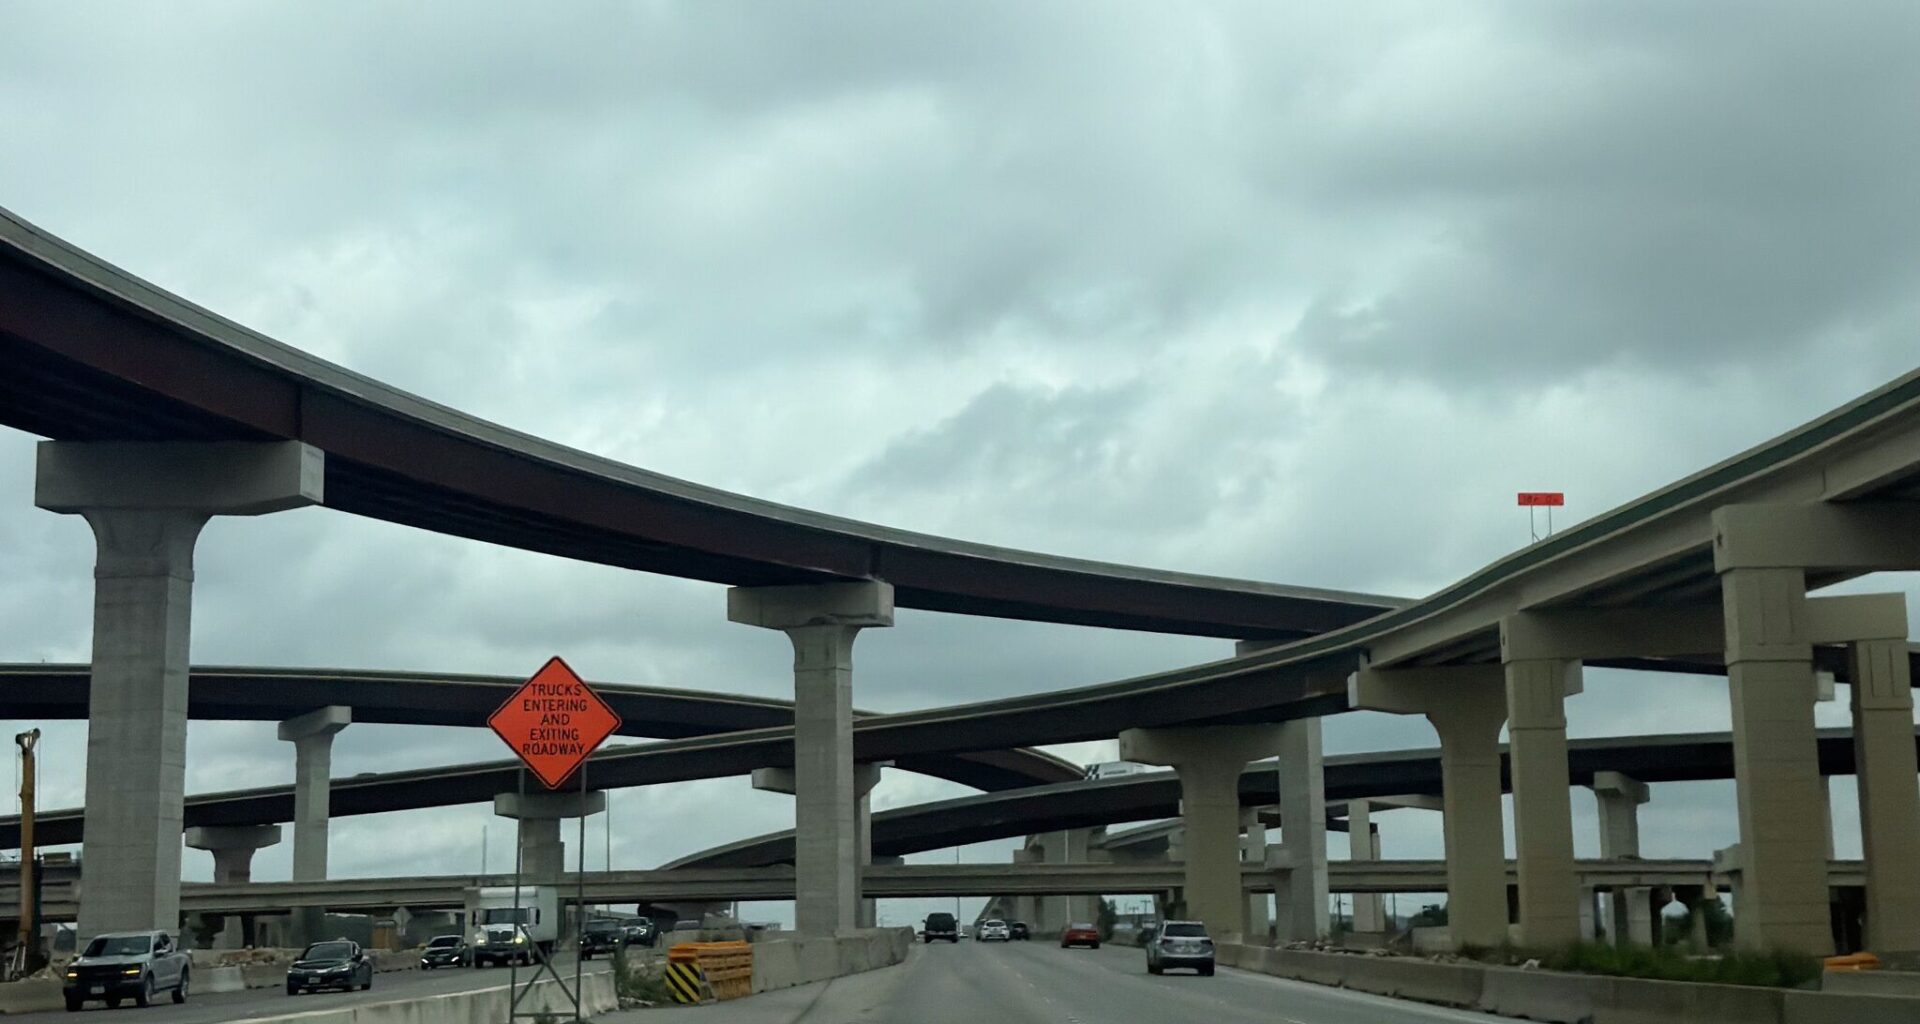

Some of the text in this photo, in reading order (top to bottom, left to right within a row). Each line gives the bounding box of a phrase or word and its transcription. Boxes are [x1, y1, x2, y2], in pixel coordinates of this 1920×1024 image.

[531, 683, 581, 696] TRUCKS
[523, 699, 587, 712] ENTERING
[540, 713, 570, 726] AND
[530, 728, 579, 741] EXITING
[522, 743, 585, 755] ROADWAY
